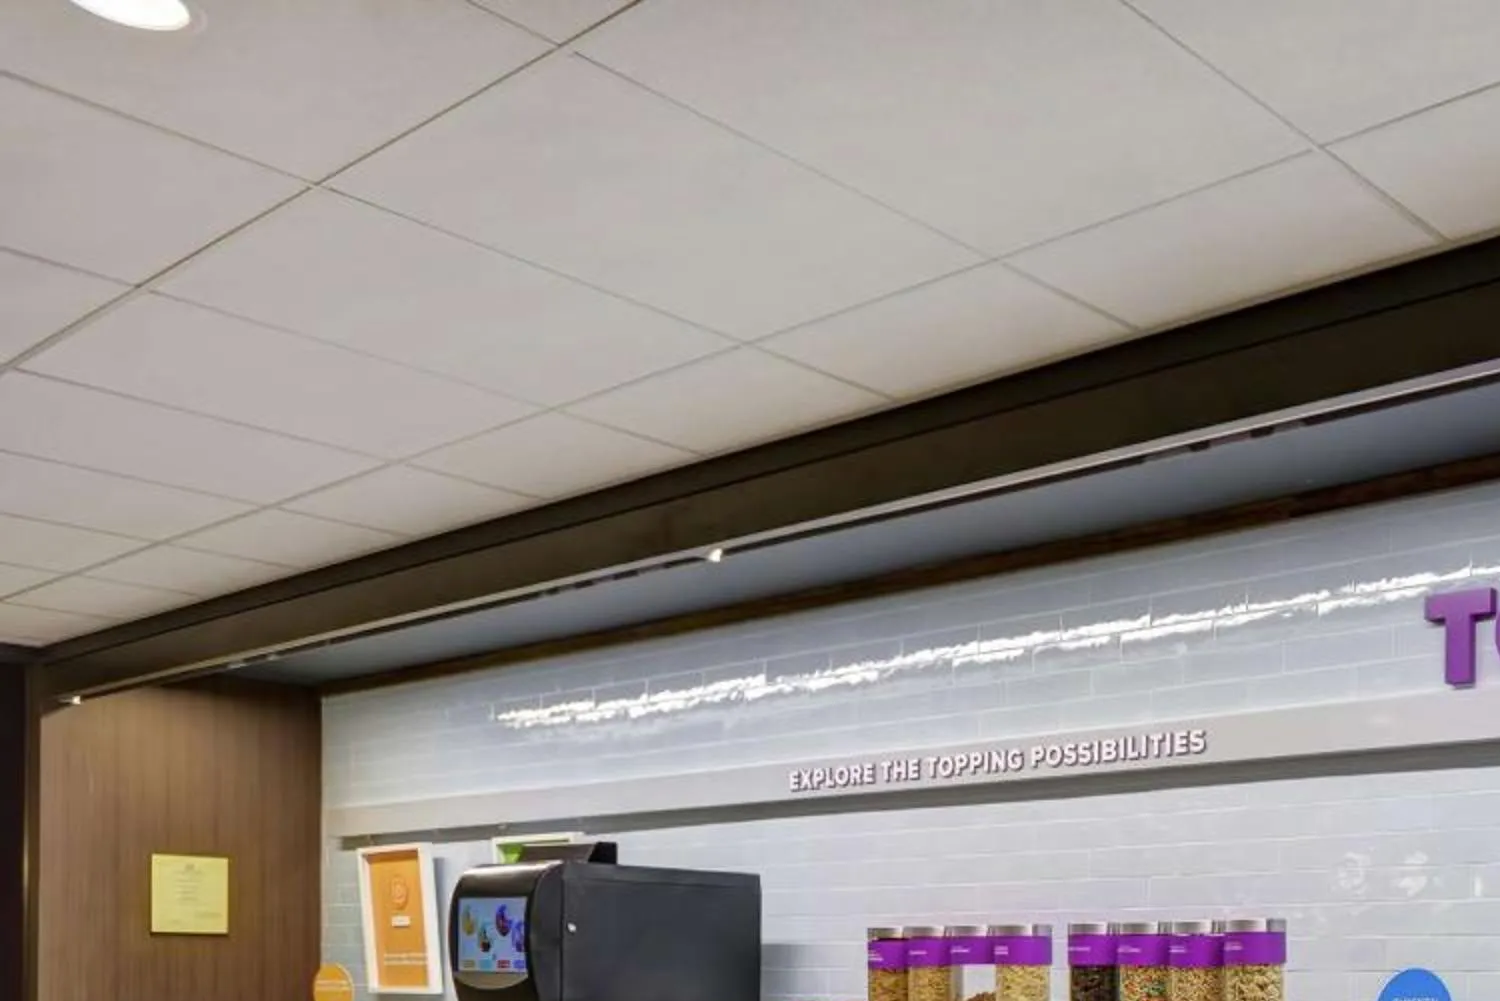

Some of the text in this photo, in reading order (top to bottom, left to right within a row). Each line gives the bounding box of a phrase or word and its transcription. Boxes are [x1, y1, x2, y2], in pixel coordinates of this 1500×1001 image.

[788, 729, 1208, 792] EXPLORE THE TOPPING POSSIBILITIES
